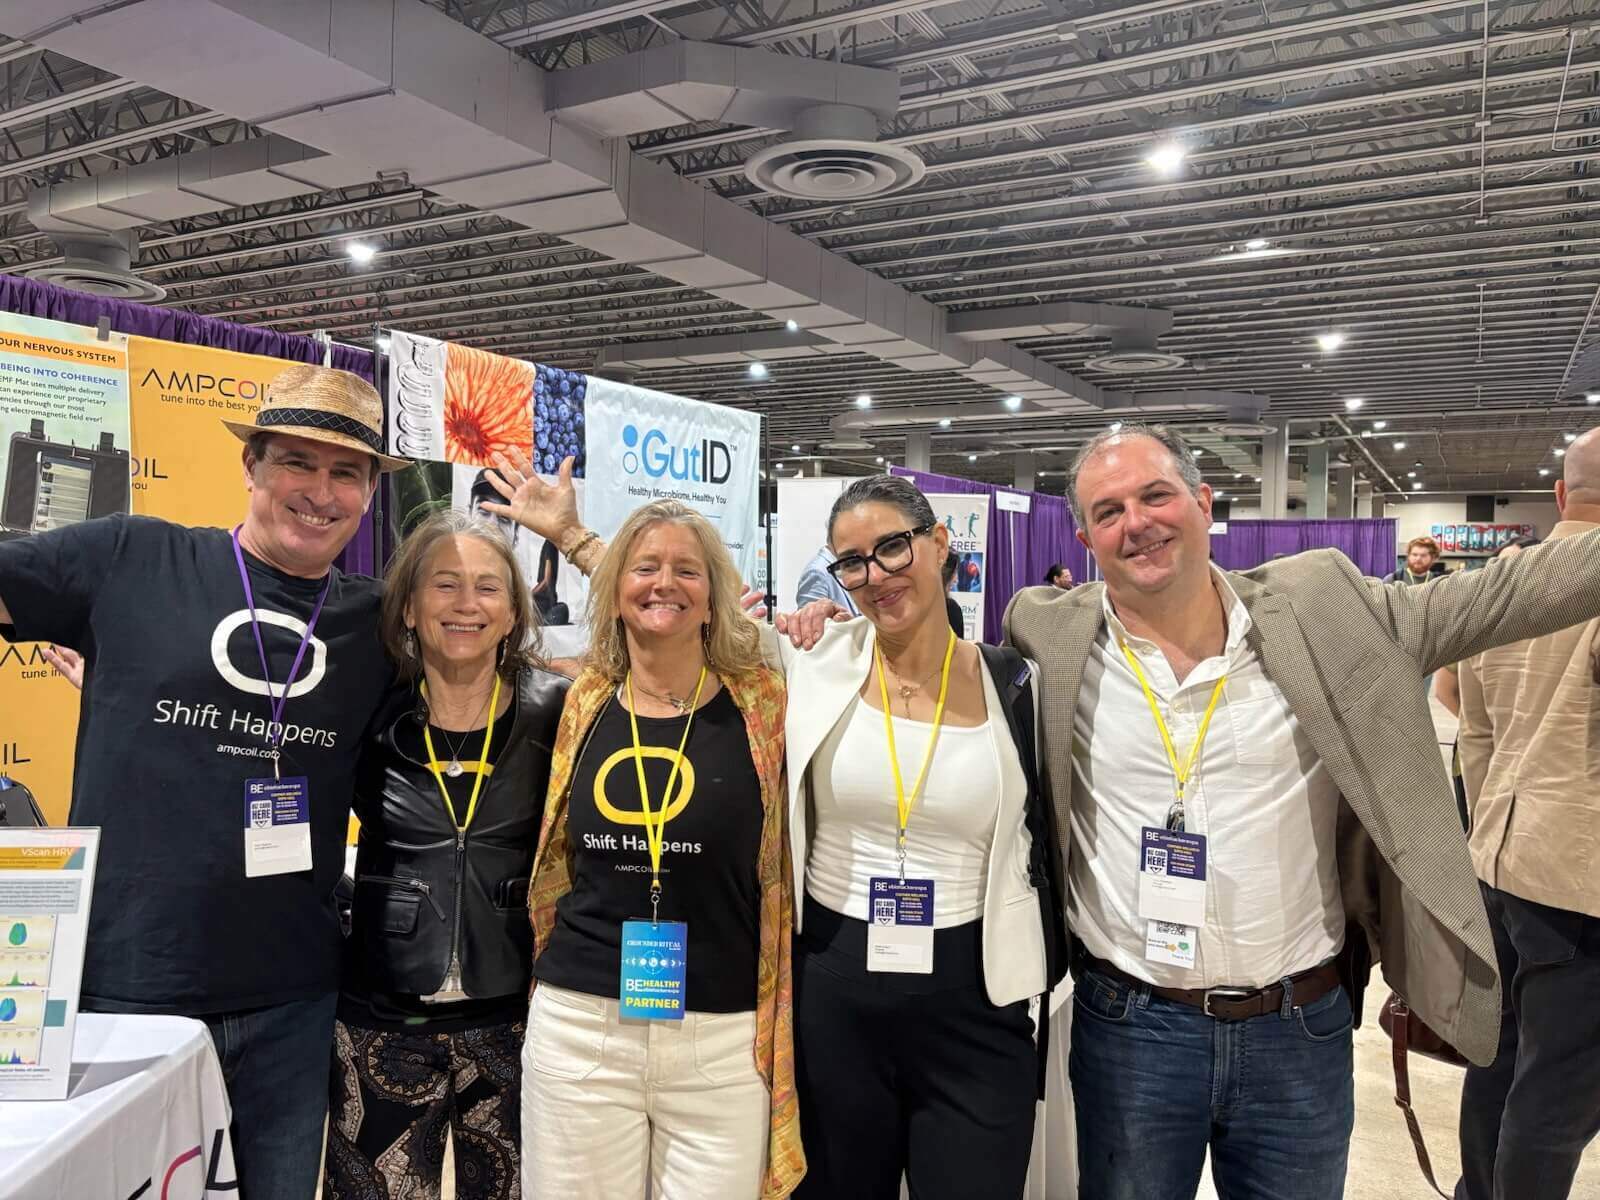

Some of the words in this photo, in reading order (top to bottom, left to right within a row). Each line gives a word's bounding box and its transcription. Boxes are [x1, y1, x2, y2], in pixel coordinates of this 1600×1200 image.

[23, 341, 74, 357] NERVOUS
[77, 350, 116, 363] SYSTEM
[0, 363, 31, 374] BEING
[33, 367, 58, 378] INTO
[60, 372, 119, 386] COHERENCE
[15, 377, 29, 386] Mat
[48, 383, 76, 393] multiple
[78, 386, 104, 397] delivery
[141, 368, 269, 402] AMPCOI
[13, 387, 51, 398] experience
[67, 394, 107, 407] proprietary
[161, 394, 183, 404] tune
[186, 395, 205, 406] into
[208, 396, 224, 408] the
[226, 400, 245, 410] best
[23, 398, 51, 409] through
[53, 401, 65, 409] our
[67, 403, 85, 412] most
[10, 405, 67, 419] electromagnetic
[69, 412, 83, 421] field
[628, 485, 651, 499] Healthy
[692, 491, 715, 504] Healthy
[715, 495, 727, 504] You
[21, 670, 48, 679] tune
[153, 699, 222, 729] Shift
[229, 709, 338, 748] Happens
[216, 743, 280, 759] ampcoil.co
[250, 783, 264, 794] BE
[252, 809, 271, 820] HERE
[583, 833, 618, 850] Shift
[622, 835, 703, 855] Hapens
[1145, 831, 1159, 842] BE
[21, 847, 50, 857] VScan
[52, 847, 73, 857] HRV
[1147, 856, 1166, 867] HERE
[875, 882, 887, 891] BE
[876, 907, 894, 917] HERE
[626, 978, 642, 992] BE
[642, 980, 681, 988] HEALTHY
[625, 996, 680, 1009] PARTNER
